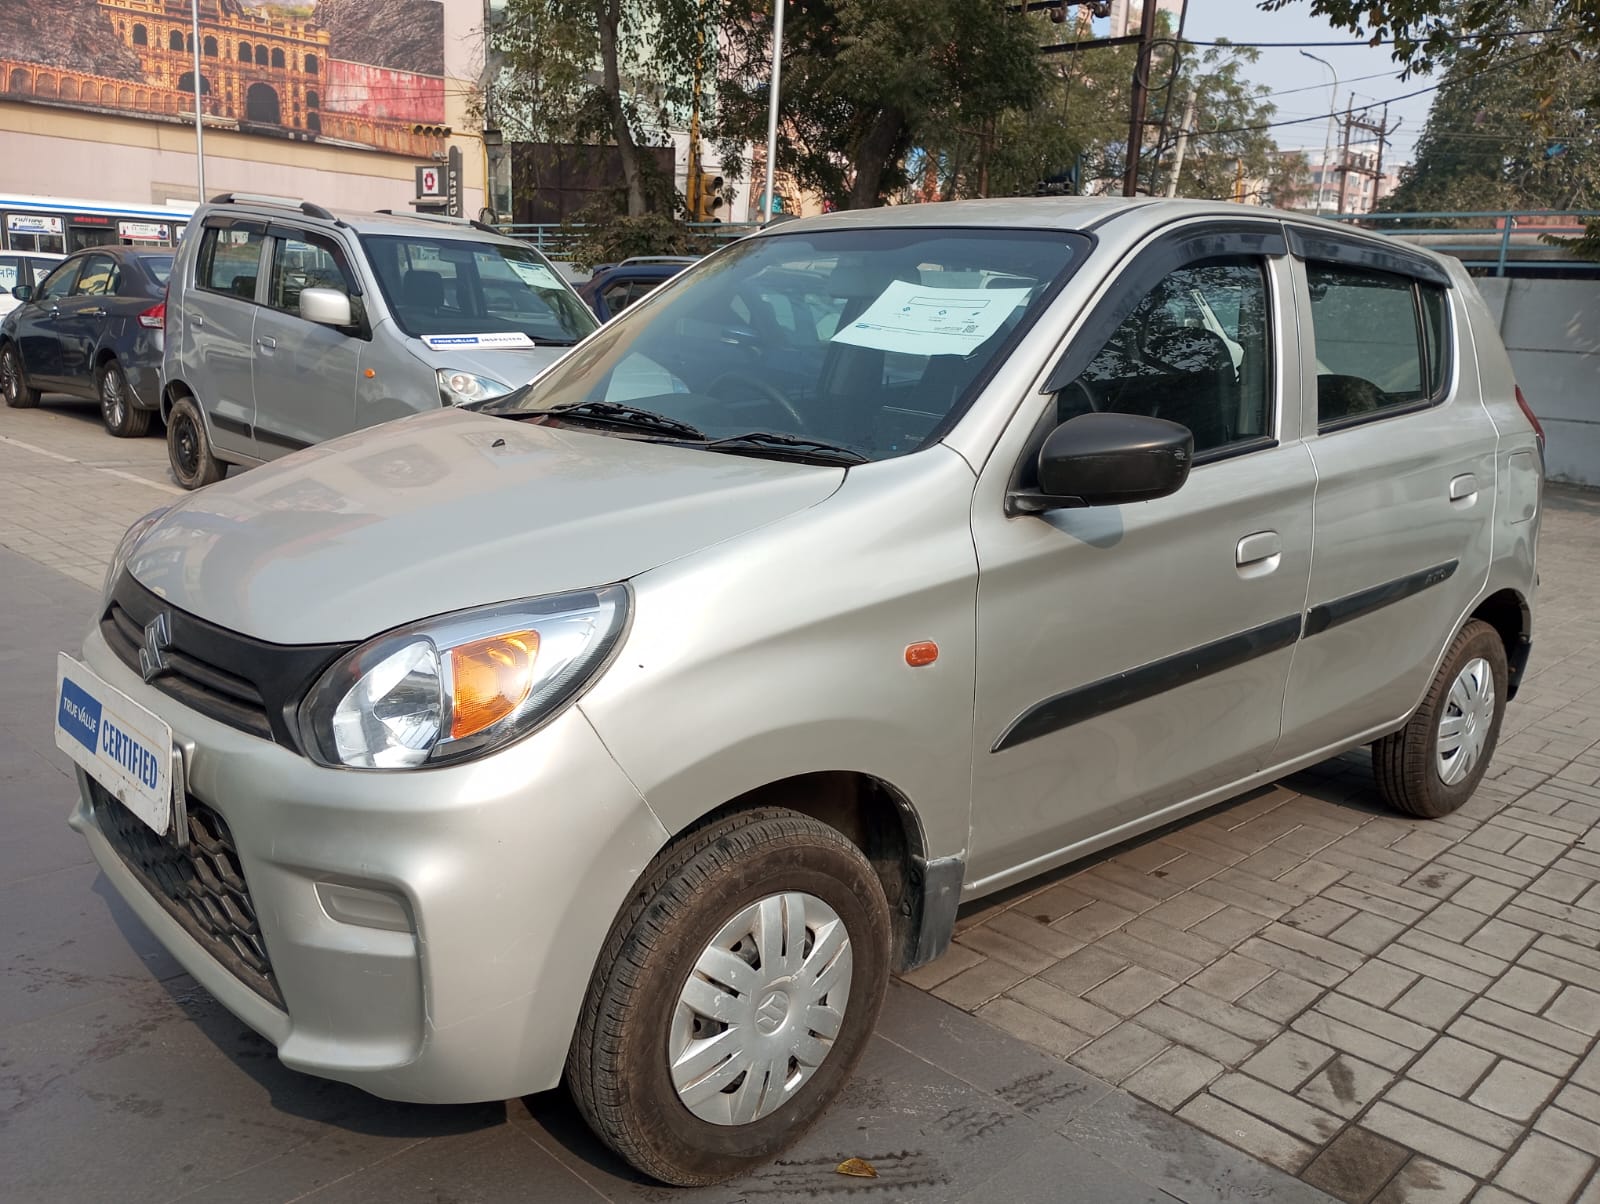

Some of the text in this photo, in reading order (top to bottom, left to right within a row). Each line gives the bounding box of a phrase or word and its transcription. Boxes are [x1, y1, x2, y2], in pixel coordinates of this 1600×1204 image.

[63, 697, 97, 733] TRUE VALUE
[103, 720, 157, 790] CERTIFIED
